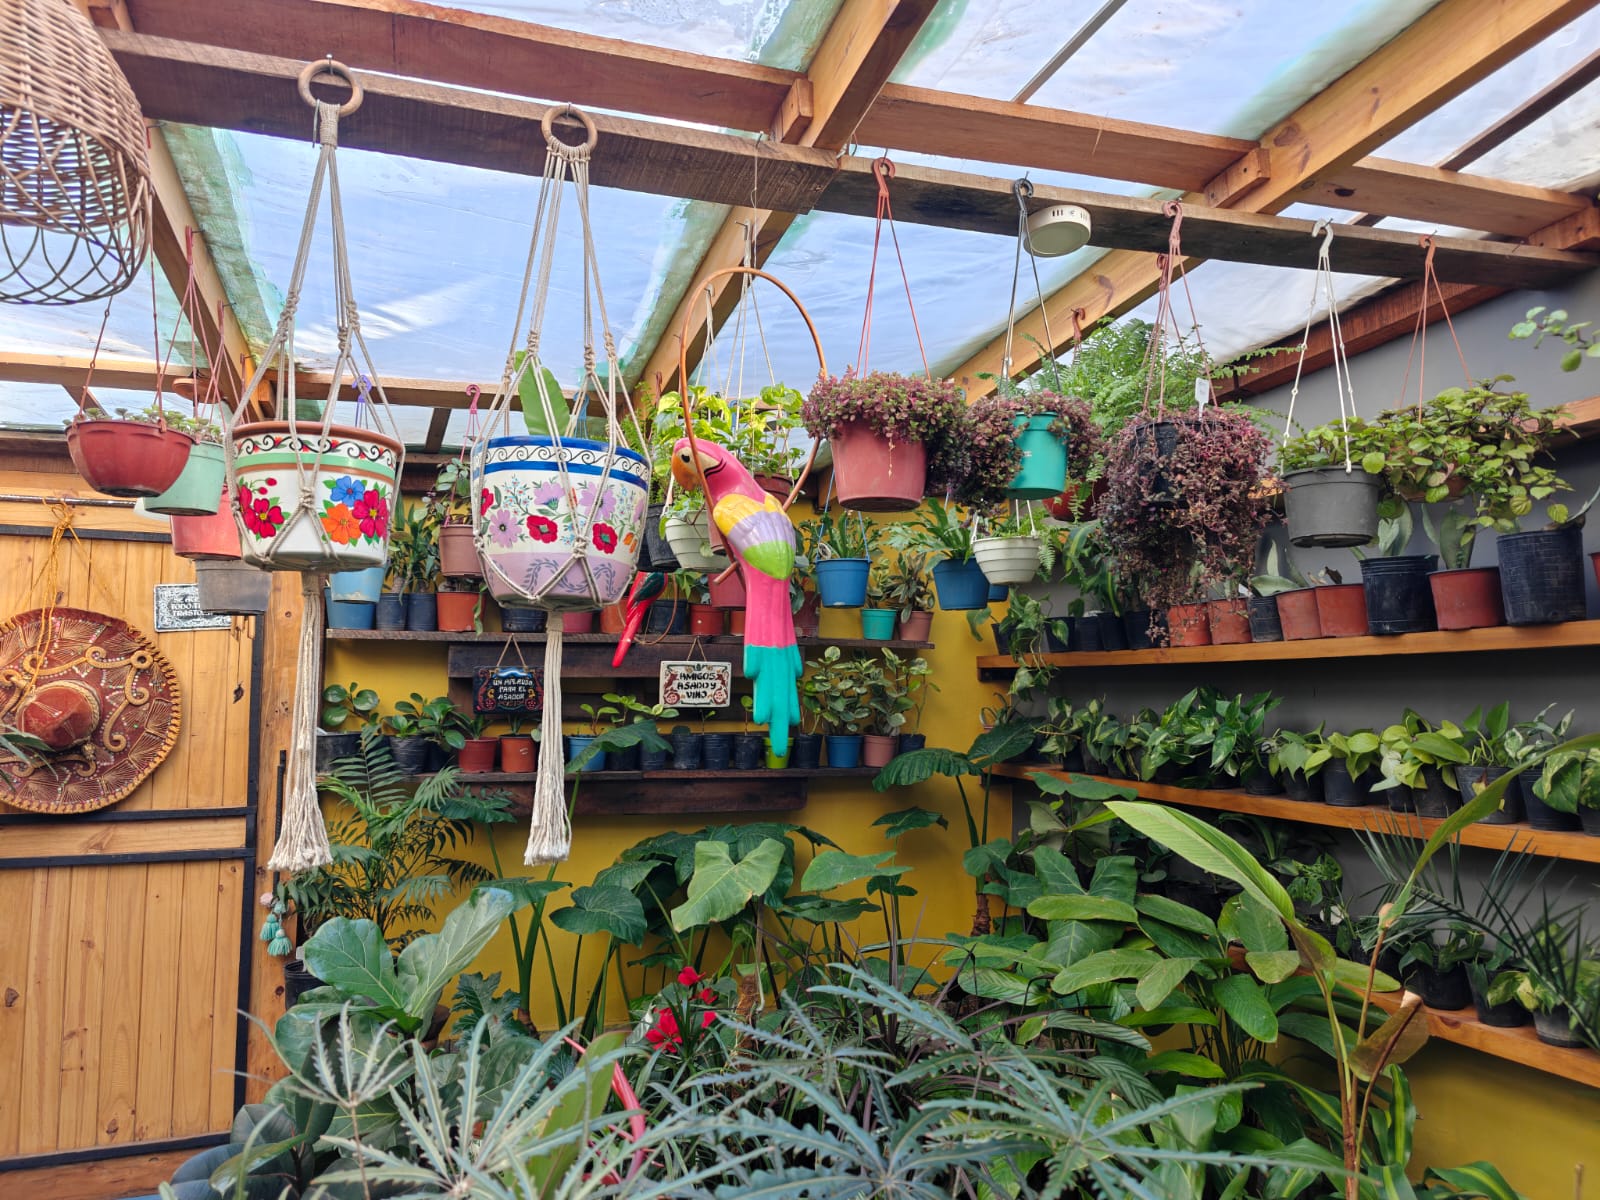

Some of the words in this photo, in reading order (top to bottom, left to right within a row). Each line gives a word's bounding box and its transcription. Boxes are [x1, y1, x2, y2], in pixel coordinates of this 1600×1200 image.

[680, 672, 716, 680] AMIGOS
[504, 678, 533, 686] APLAUSO
[677, 682, 709, 690] ASADO
[686, 690, 707, 699] VINO
